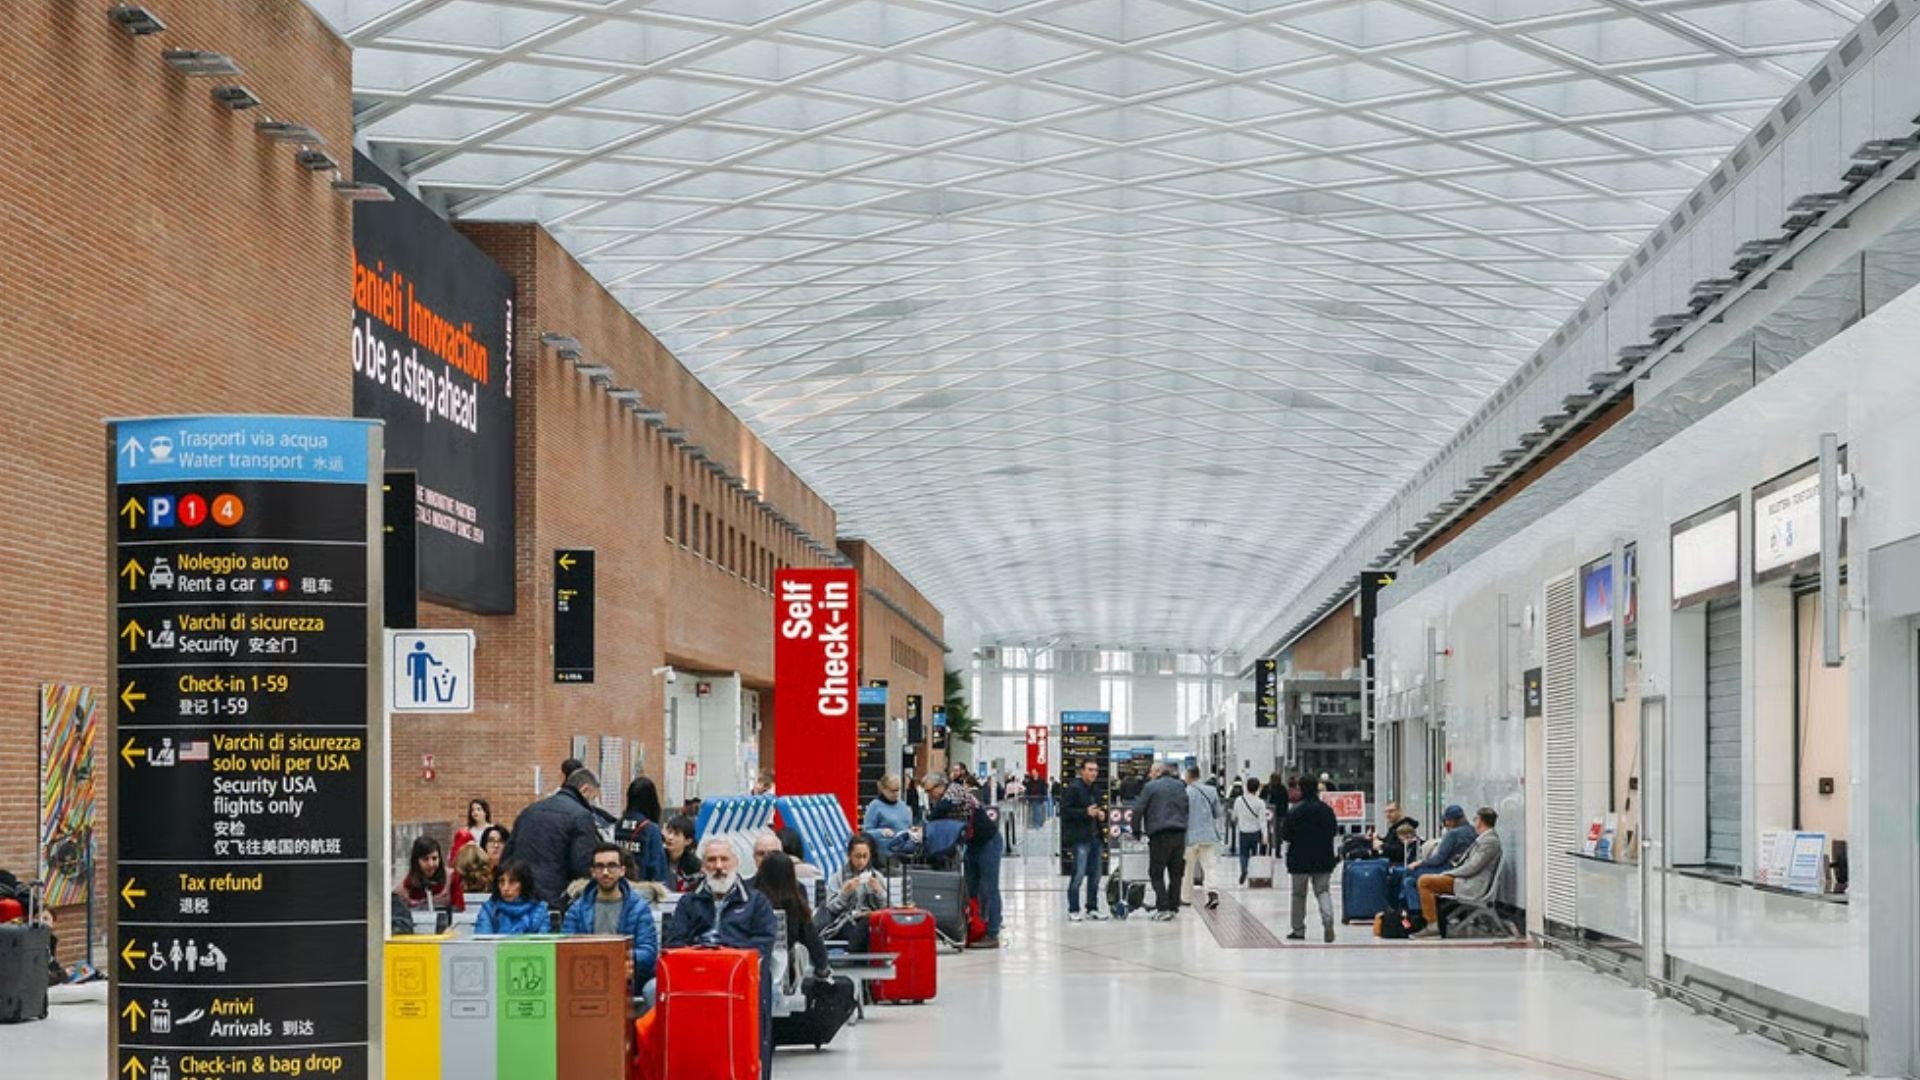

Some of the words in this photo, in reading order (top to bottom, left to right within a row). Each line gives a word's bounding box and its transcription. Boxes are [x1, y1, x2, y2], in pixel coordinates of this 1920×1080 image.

[408, 282, 488, 384] Innovaction
[366, 318, 387, 384] be
[391, 350, 401, 393] a
[404, 348, 435, 423] step
[438, 365, 478, 433] ahead
[178, 429, 246, 450] Trasporti
[249, 429, 275, 447] via
[279, 433, 328, 452] acqua
[178, 451, 225, 468] Water
[227, 452, 304, 472] transport
[152, 497, 171, 525] P
[188, 500, 195, 520] 1
[221, 500, 234, 519] 4
[177, 552, 248, 575] Noleggio
[250, 555, 289, 571] auto
[177, 575, 213, 593] Rent
[215, 578, 226, 592] a
[230, 577, 257, 592] car
[301, 577, 333, 594] 租车
[782, 581, 813, 639] Self
[178, 613, 226, 632] Varchi
[230, 613, 246, 631] di
[250, 614, 325, 632] sicurezza
[178, 635, 240, 657] Security
[248, 636, 297, 654] 安全门
[818, 581, 849, 716] Check-in
[178, 674, 246, 693] Check-in
[251, 674, 289, 693] 1-59
[212, 697, 249, 715] 1-59
[212, 732, 265, 751] Varchi
[268, 732, 285, 751] di
[288, 733, 361, 751] sicurezza
[212, 753, 246, 772] solo
[249, 753, 281, 771] voli
[285, 757, 312, 775] per
[316, 753, 351, 771] USA
[213, 775, 278, 797] Security
[282, 775, 318, 793] USA
[213, 795, 265, 817] flights
[267, 795, 304, 818] only
[214, 820, 246, 837] 安检
[179, 873, 206, 892] Tax
[209, 872, 263, 891] refund
[210, 997, 254, 1015] Arrivi
[210, 1018, 273, 1037] Arrivals
[282, 1019, 314, 1036] 到达
[179, 1055, 247, 1074] Check-in
[251, 1055, 265, 1073] &
[269, 1055, 301, 1076] bag
[304, 1053, 342, 1073] drop
